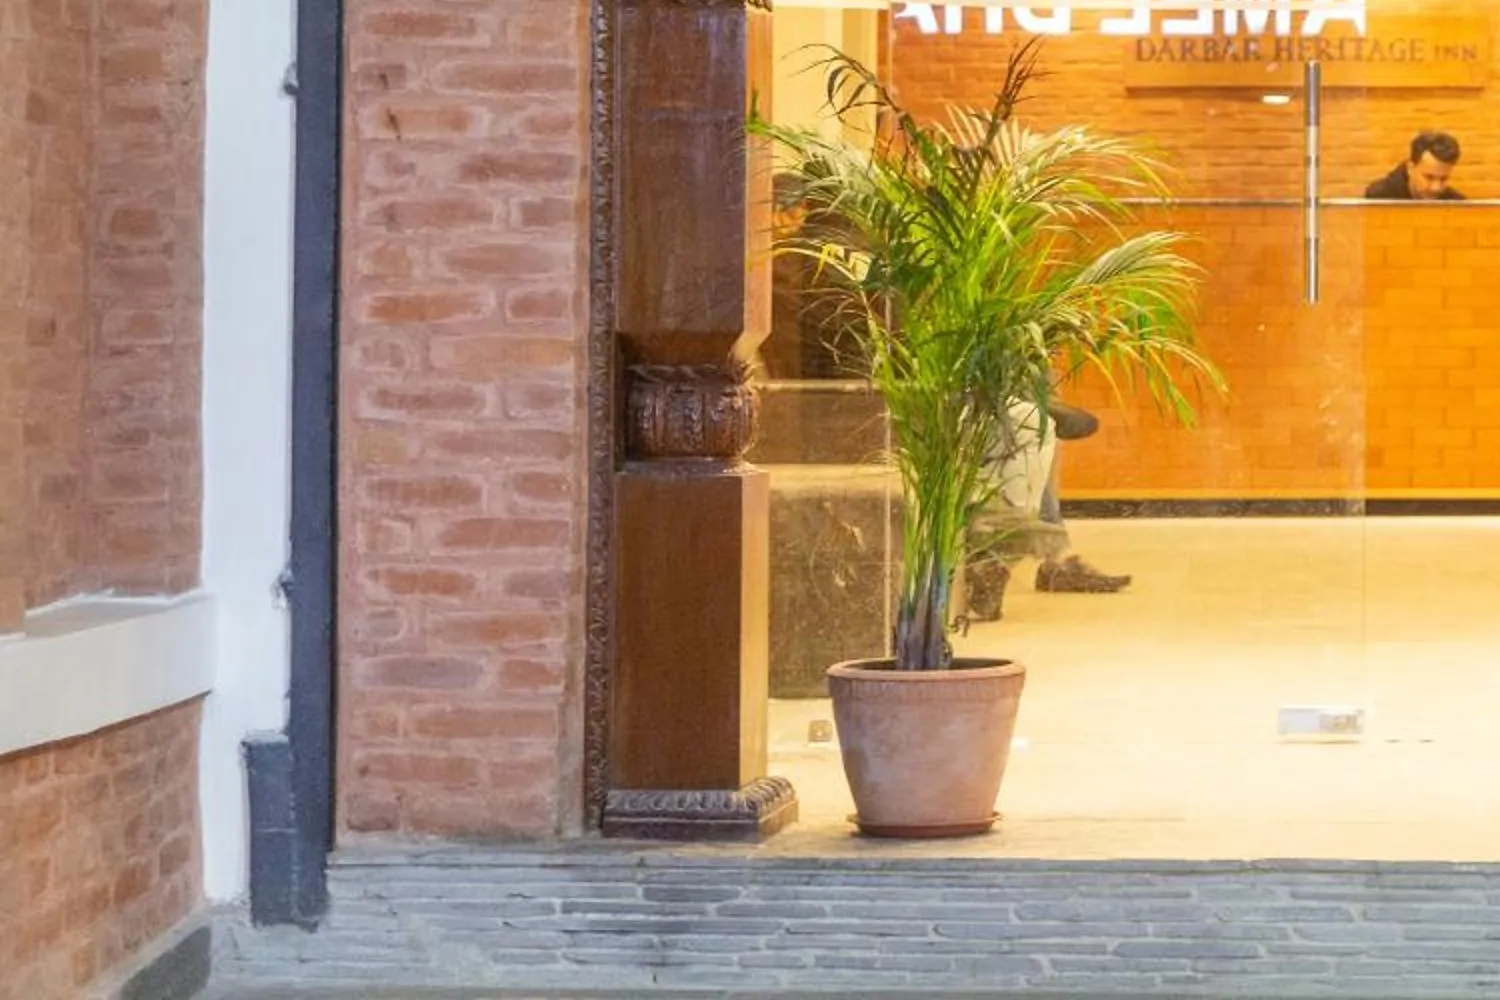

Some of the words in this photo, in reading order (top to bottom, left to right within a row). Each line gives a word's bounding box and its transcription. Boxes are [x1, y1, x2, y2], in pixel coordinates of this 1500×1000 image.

[1136, 37, 1261, 62] DARBAR
[1274, 36, 1425, 62] HERITAGE
[1434, 44, 1478, 61] INN
